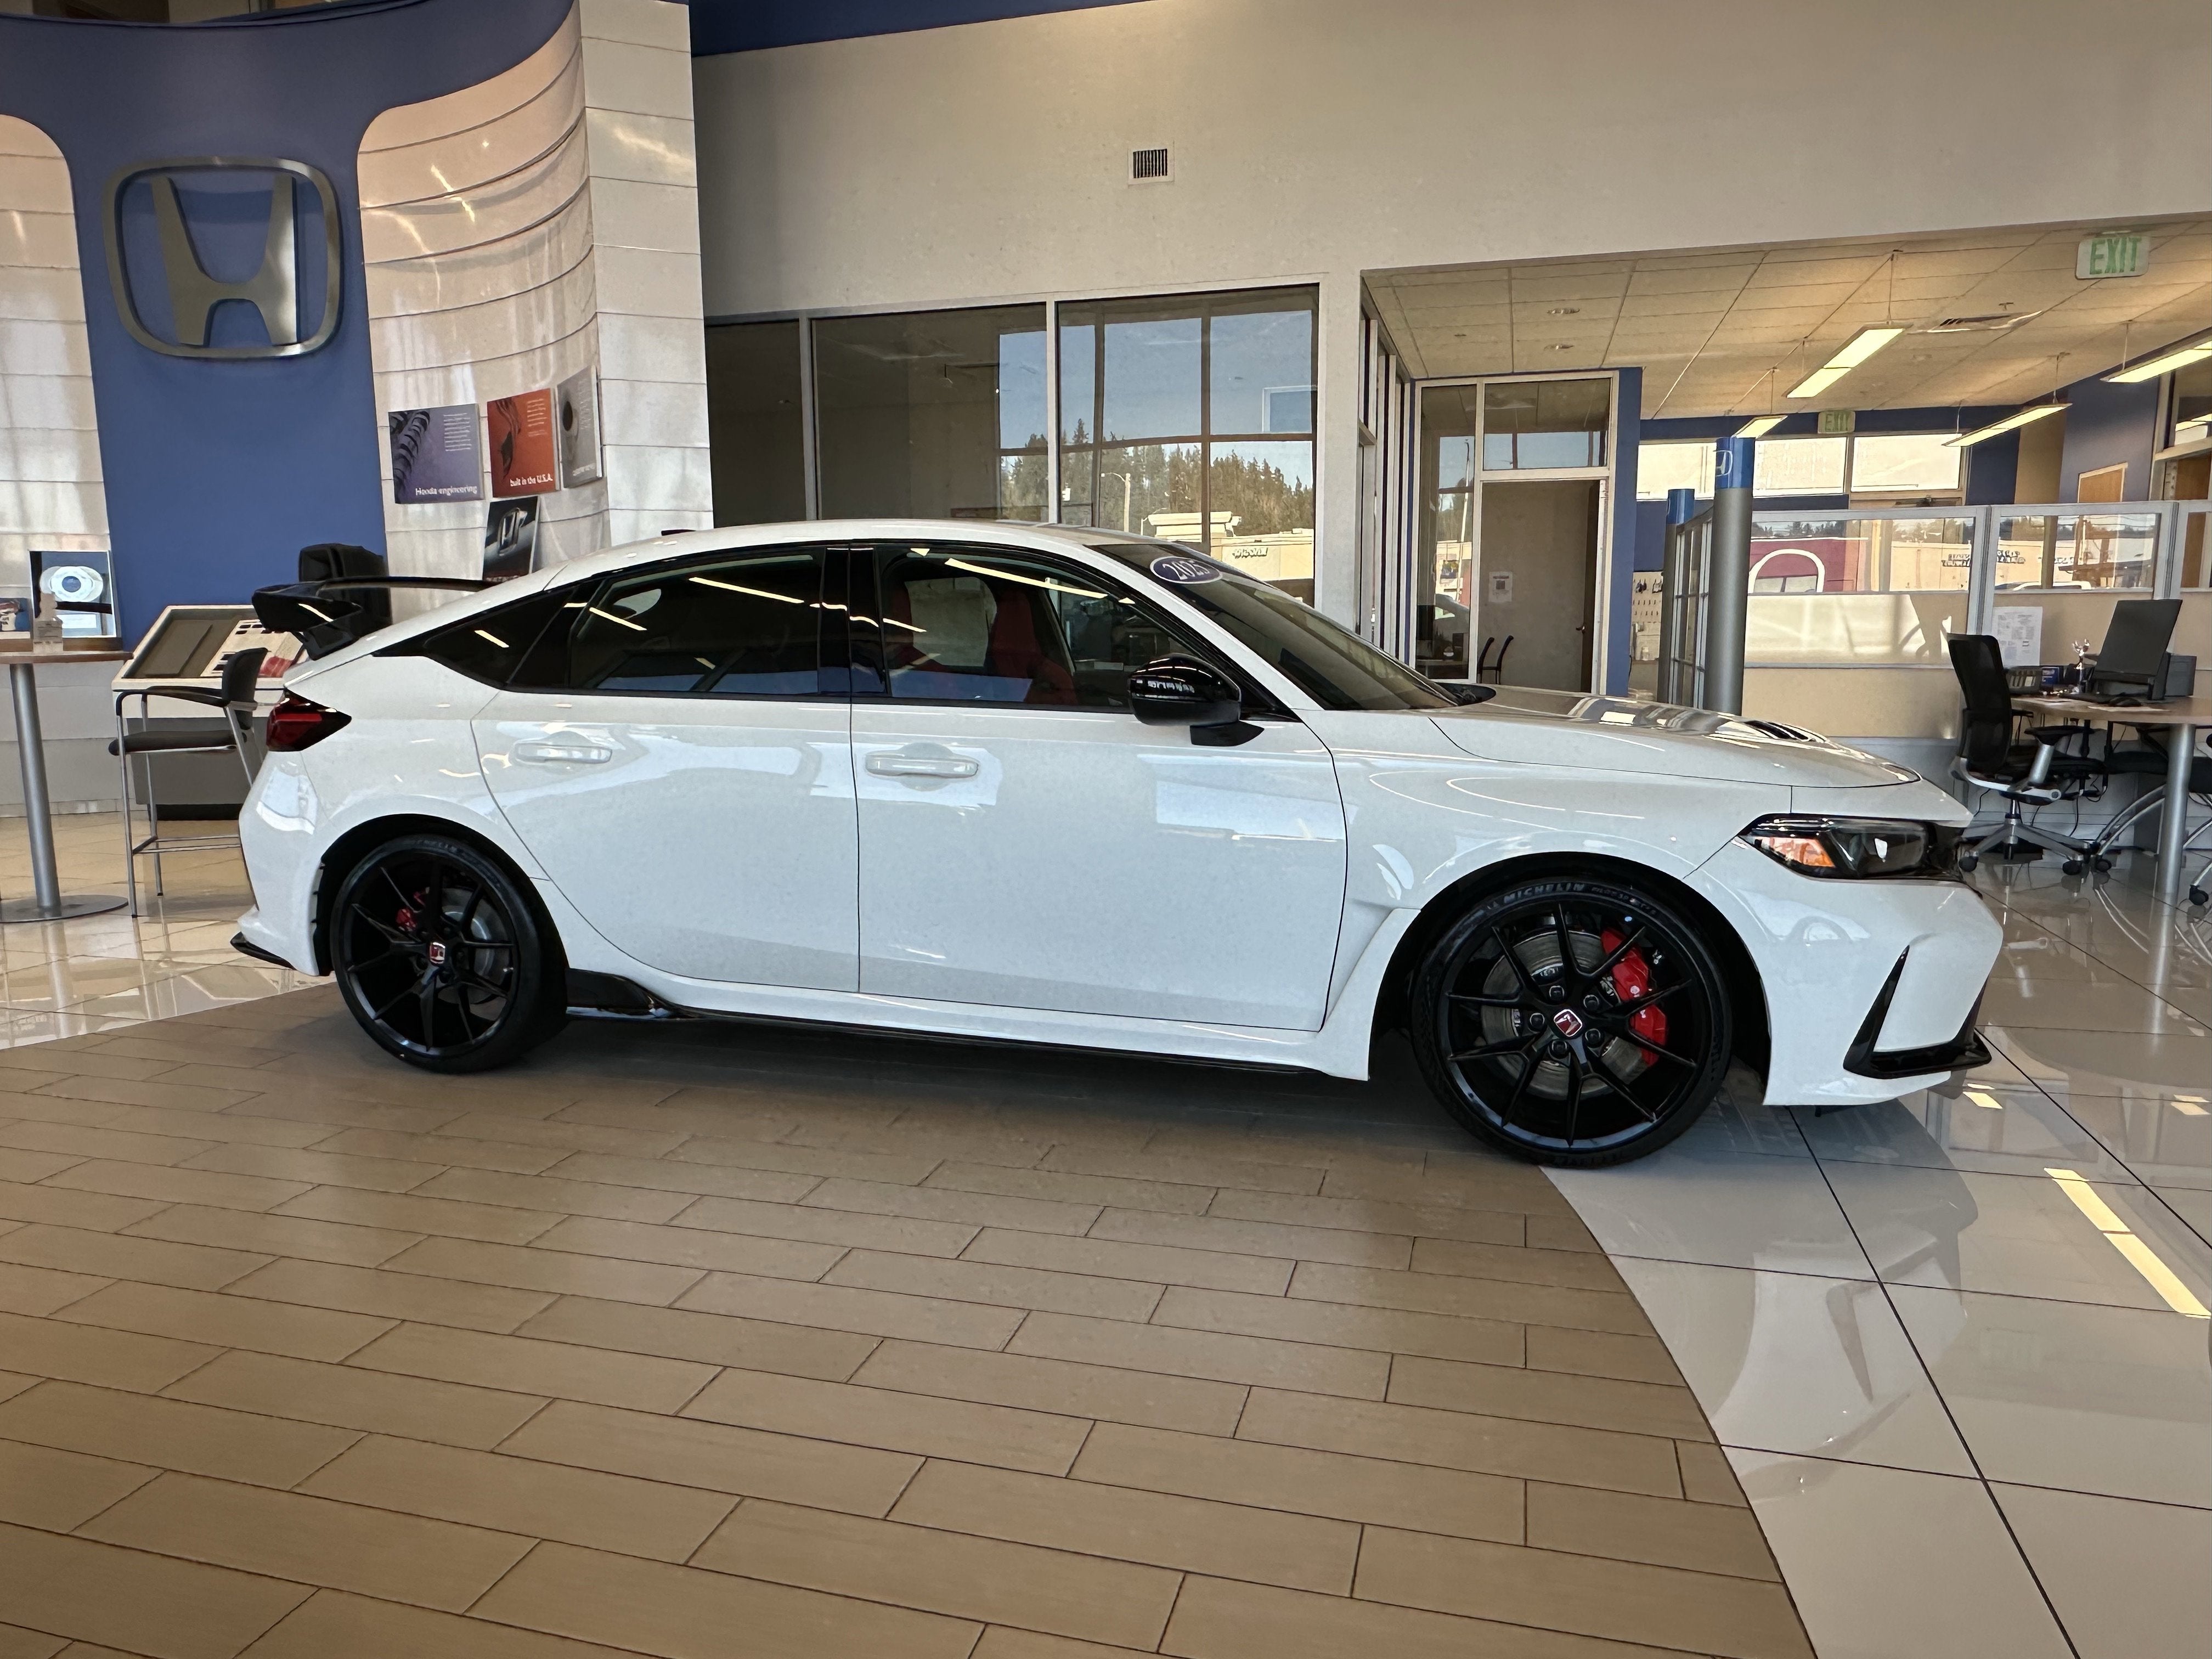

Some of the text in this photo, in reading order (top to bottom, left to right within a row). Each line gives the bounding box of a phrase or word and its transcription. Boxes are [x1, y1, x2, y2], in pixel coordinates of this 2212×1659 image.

[2089, 236, 2143, 275] EXIT
[415, 484, 477, 496] Honda engineering
[1162, 558, 1210, 580] 2025
[1503, 883, 1585, 904] MICHELIN
